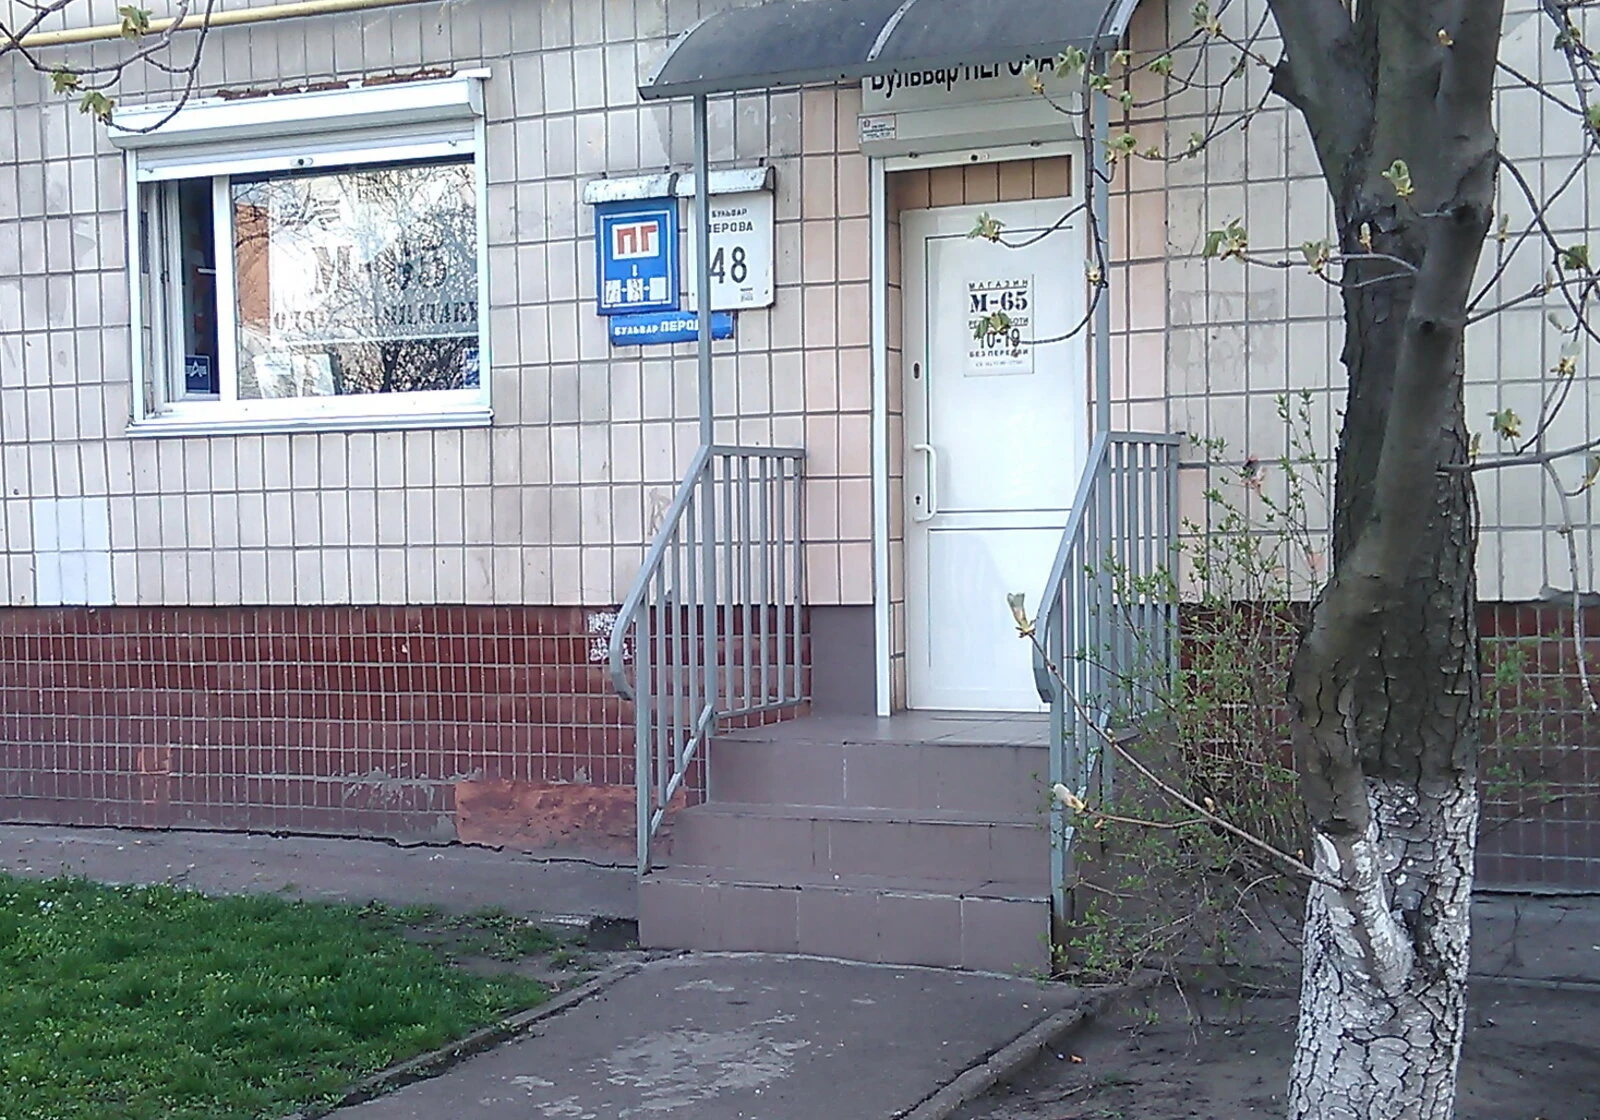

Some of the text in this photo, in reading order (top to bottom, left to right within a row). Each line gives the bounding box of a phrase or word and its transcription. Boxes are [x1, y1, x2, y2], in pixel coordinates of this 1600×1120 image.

[965, 57, 1054, 80] ПЕОА
[712, 208, 748, 218] БУЛЬВАР
[616, 225, 657, 254] ПГ
[708, 246, 747, 283] 48
[968, 280, 1028, 289] МАГАЗИН
[614, 324, 658, 336] БУЛЬВАР
[988, 349, 1029, 357] ПЕРЕИ
